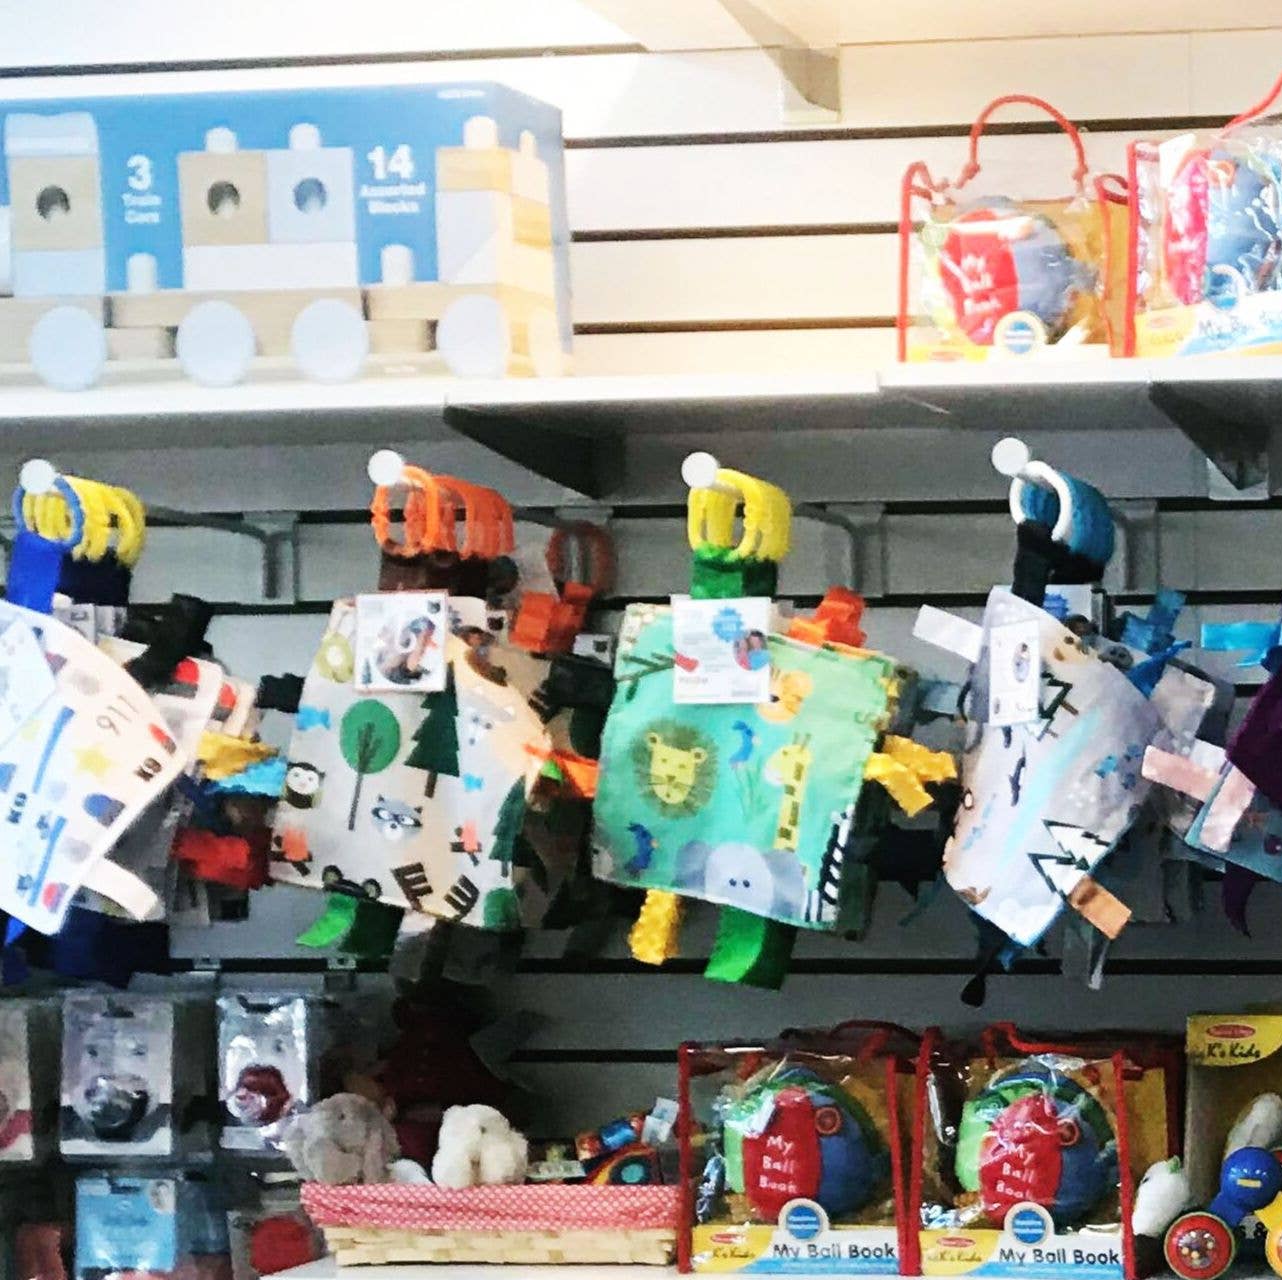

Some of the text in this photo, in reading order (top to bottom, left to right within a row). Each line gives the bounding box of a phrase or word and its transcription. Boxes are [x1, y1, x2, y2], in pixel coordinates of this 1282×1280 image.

[127, 154, 151, 190] 3
[367, 144, 415, 180] 14
[766, 1135, 793, 1154] My
[1008, 1142, 1034, 1166] My
[762, 1155, 794, 1174] Ball
[1002, 1162, 1036, 1184] Ball
[773, 1243, 800, 1259] My
[848, 1243, 896, 1259] Book
[1000, 1249, 1119, 1265] My Ball Book
